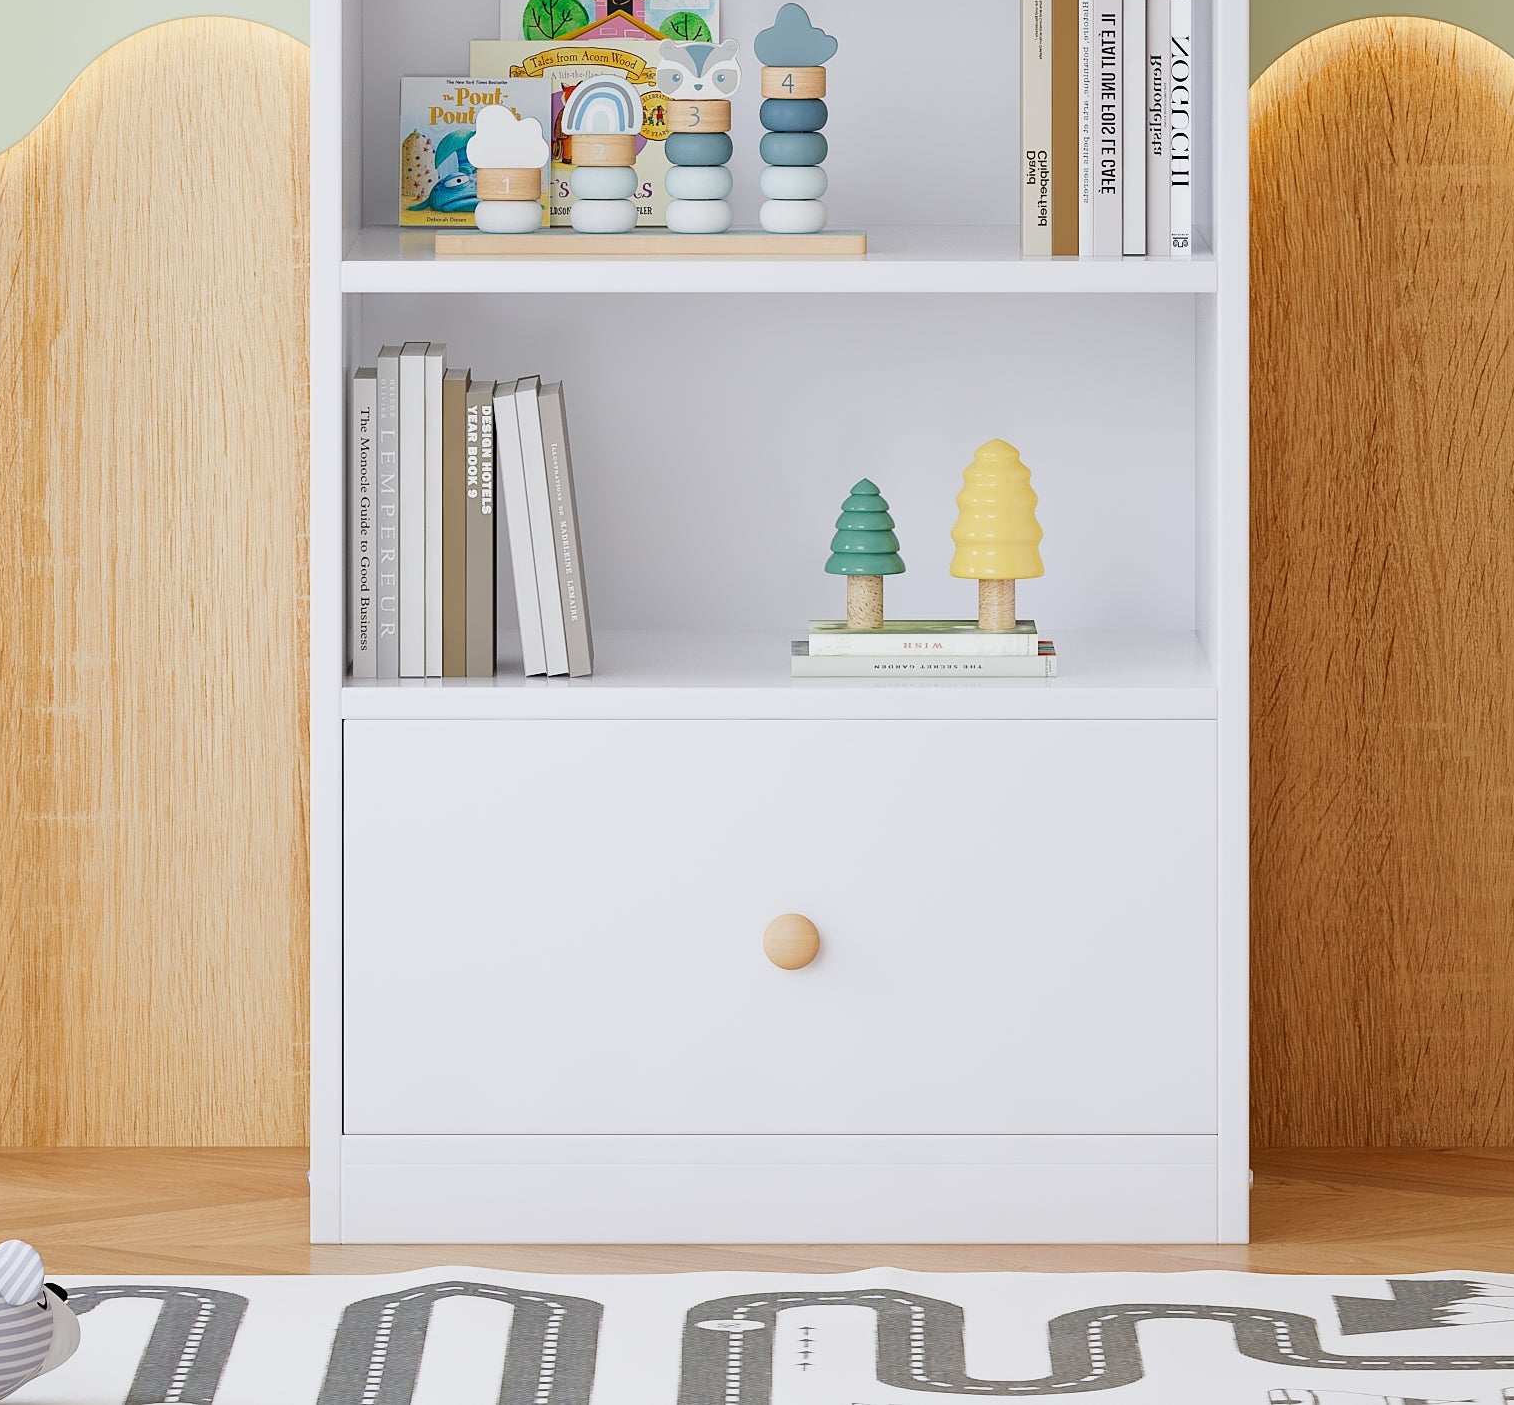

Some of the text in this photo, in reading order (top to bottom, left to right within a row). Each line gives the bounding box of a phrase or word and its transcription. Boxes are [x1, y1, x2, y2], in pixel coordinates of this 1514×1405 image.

[529, 50, 638, 70] Tales from Acorn Wood
[551, 71, 557, 80] A
[781, 73, 795, 94] 4
[454, 87, 508, 106] Pout-
[428, 106, 476, 125] Pout
[688, 106, 700, 127] 3
[594, 143, 607, 160] 2
[501, 177, 510, 193] 1
[467, 404, 478, 499] YEAR BOOK 9
[481, 405, 492, 515] DESIGN HOTELS
[360, 406, 371, 651] The Monocle Guide to Good Business
[380, 429, 396, 639] LEMPEREUR
[560, 520, 573, 575] MADELEINE
[566, 579, 579, 622] LEMAIRE
